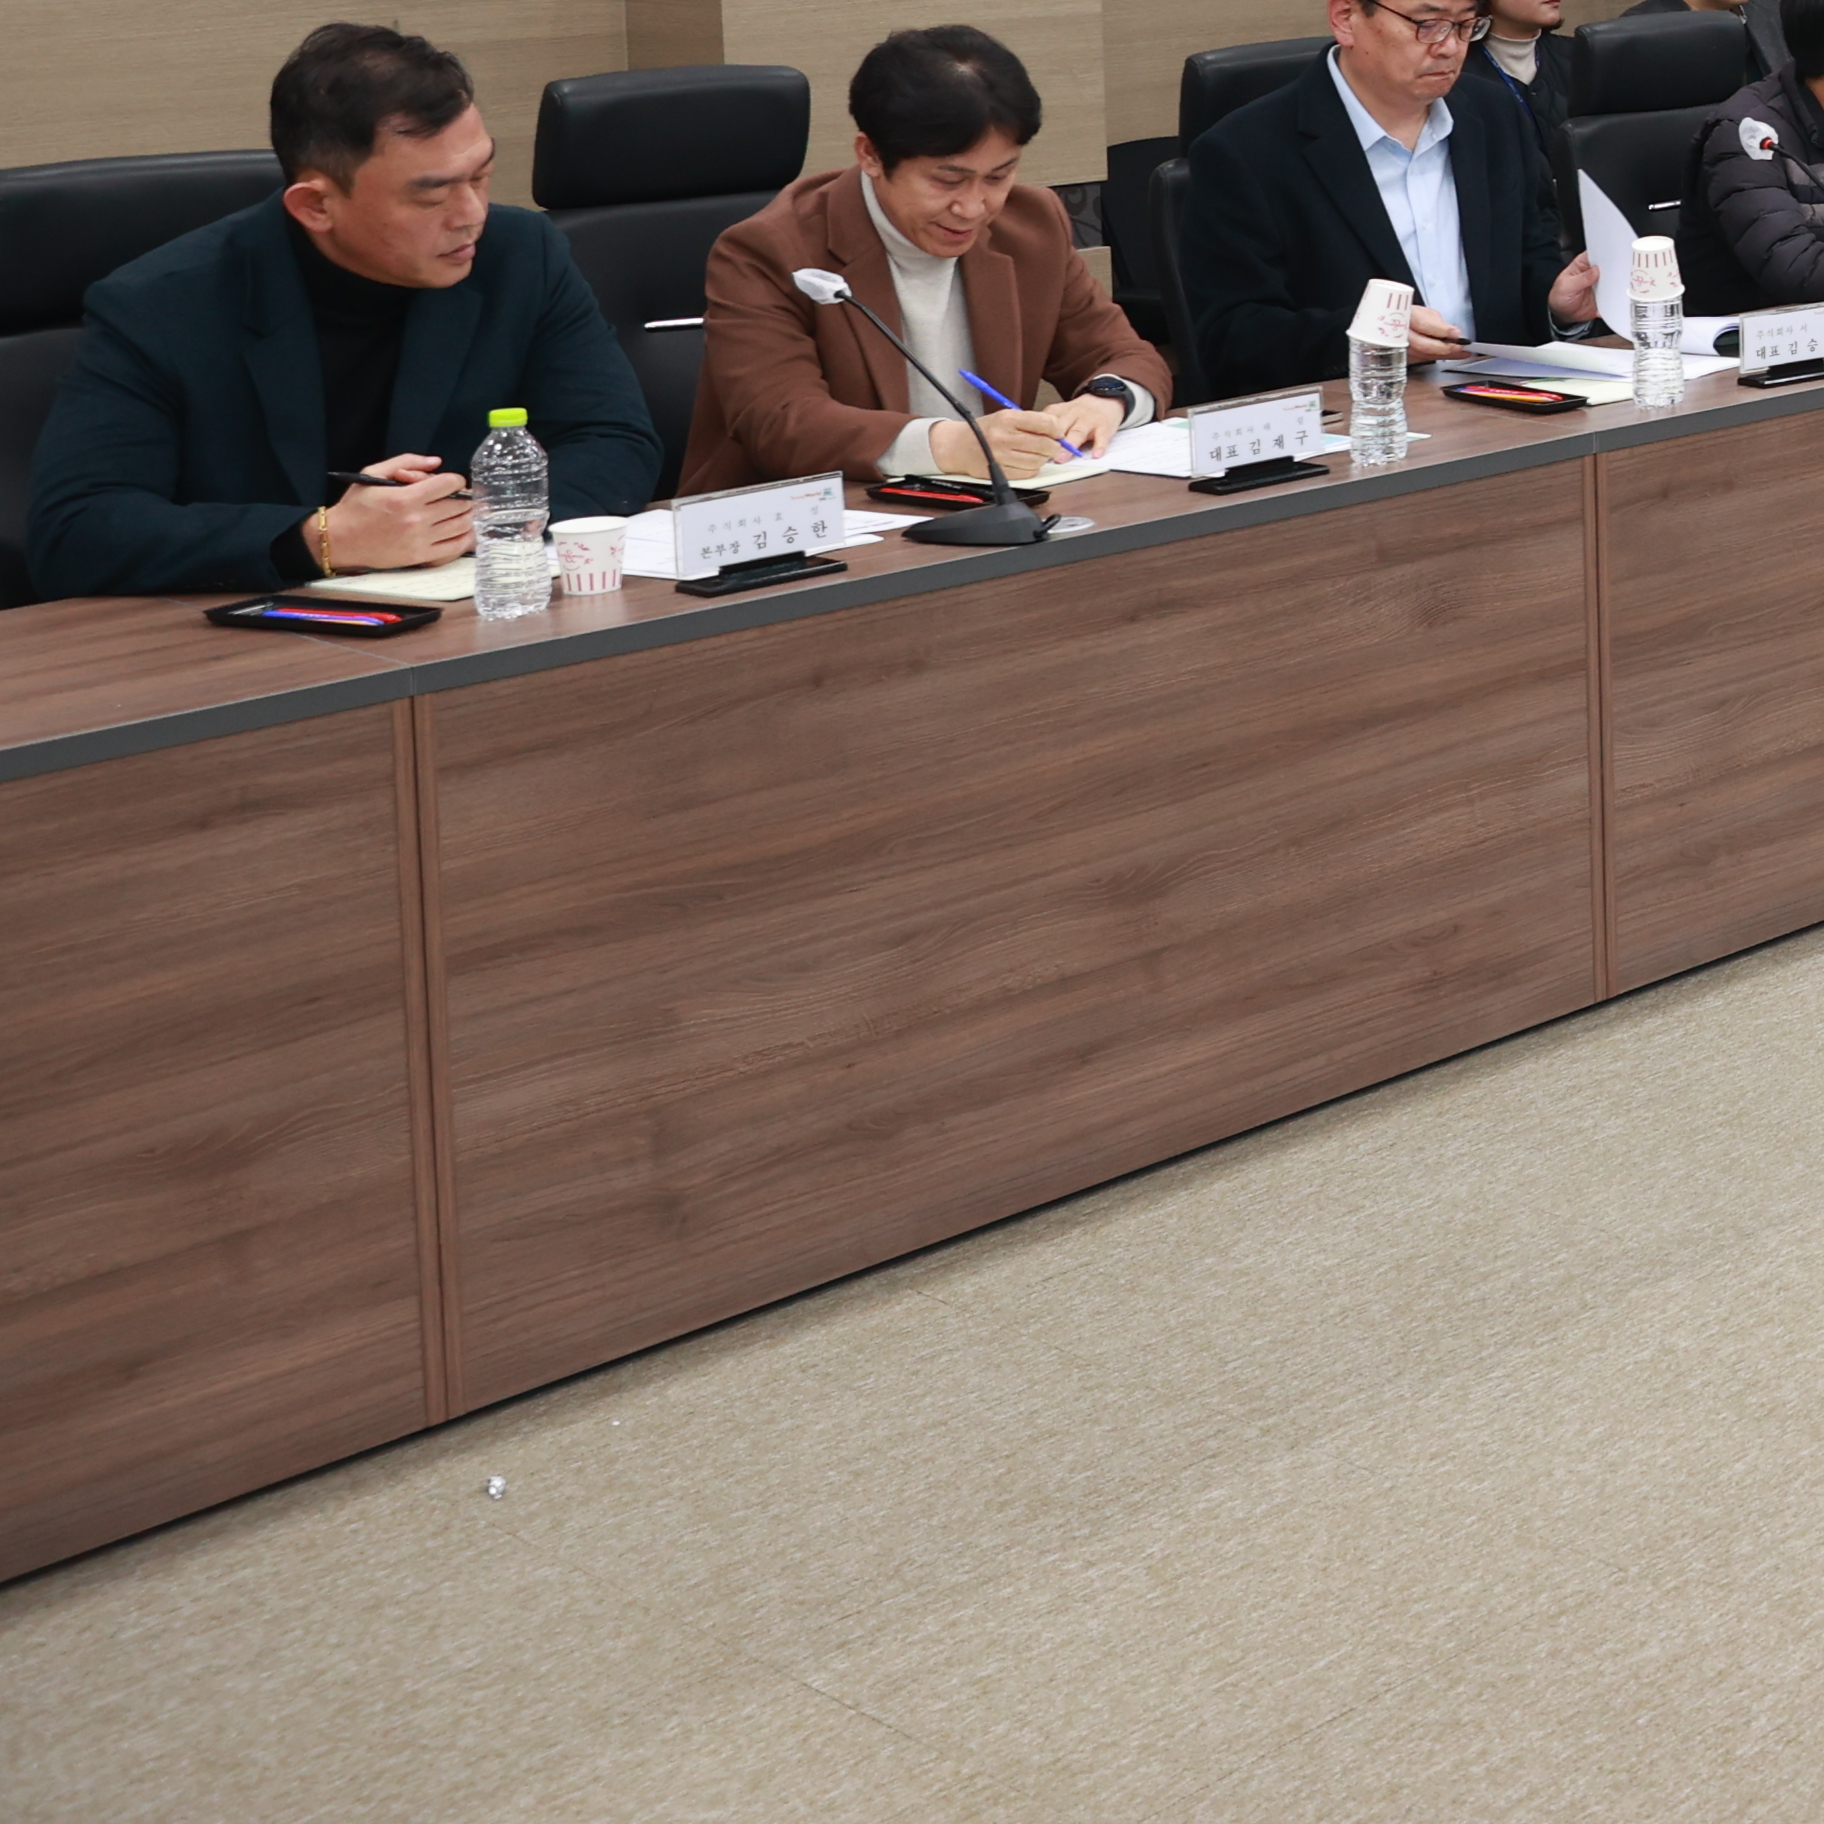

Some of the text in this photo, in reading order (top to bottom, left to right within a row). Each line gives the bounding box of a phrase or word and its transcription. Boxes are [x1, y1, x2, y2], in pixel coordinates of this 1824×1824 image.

[1756, 325, 1794, 340] 주식회사
[1755, 345, 1780, 359] 대표
[1211, 426, 1255, 441] 주식회사
[1208, 430, 1309, 462] 대표 김재구
[707, 514, 762, 534] 주식회사
[700, 519, 828, 560] 본부장 김승한
